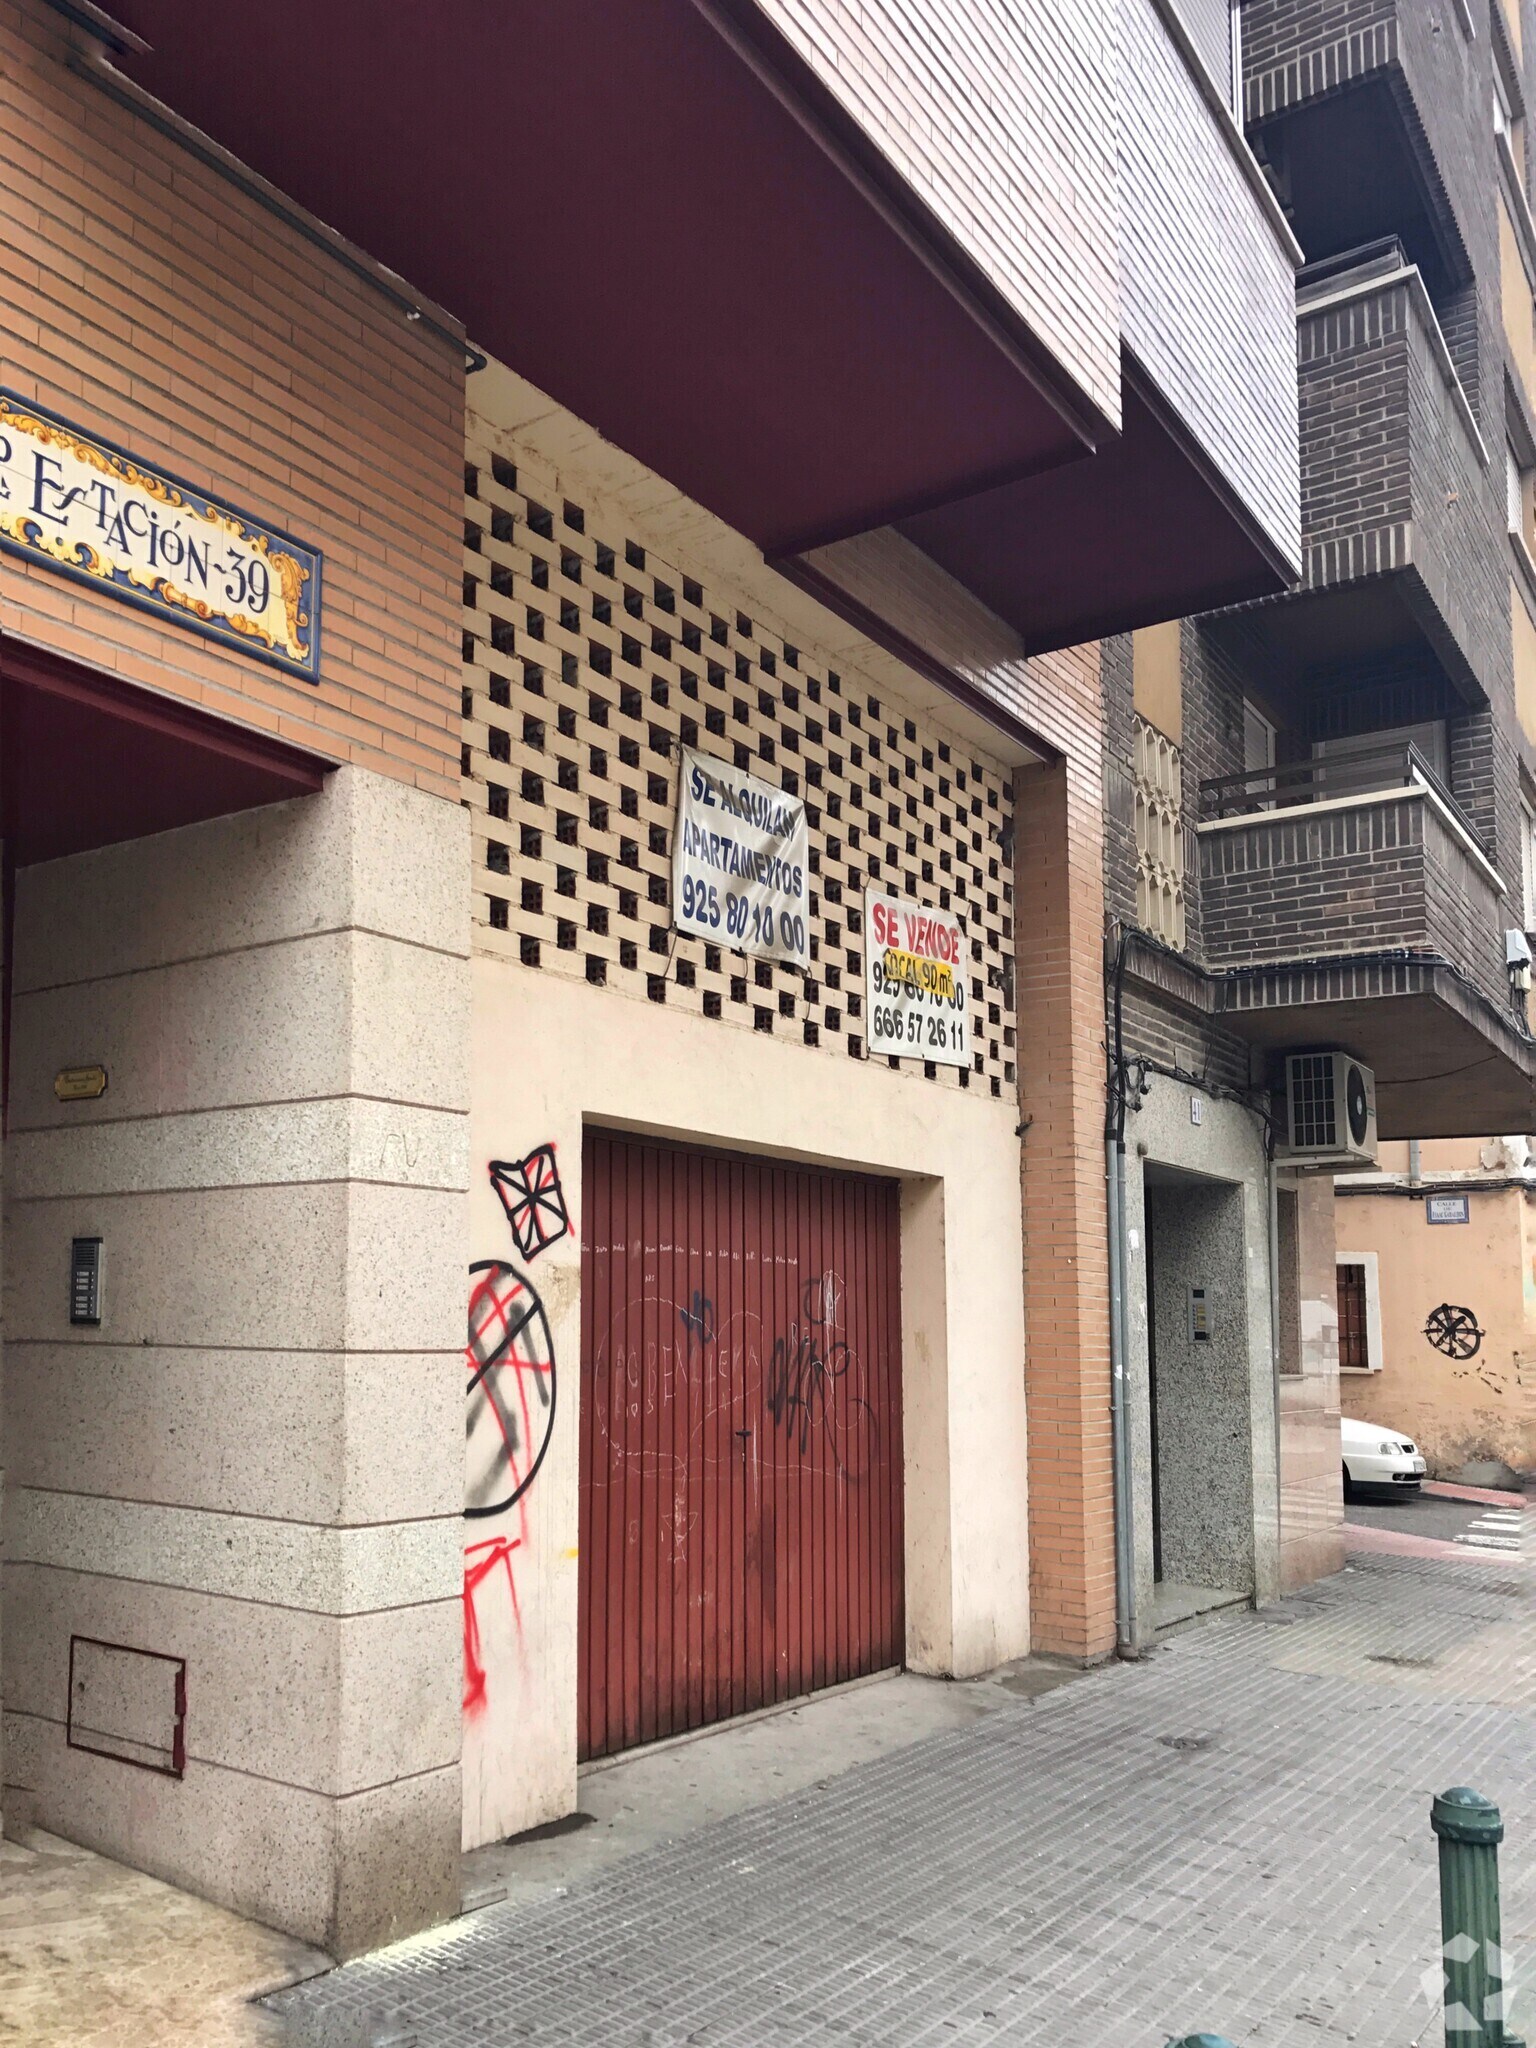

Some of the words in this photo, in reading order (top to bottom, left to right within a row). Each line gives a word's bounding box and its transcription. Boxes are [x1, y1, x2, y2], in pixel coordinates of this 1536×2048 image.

[691, 766, 716, 807] SE
[720, 780, 797, 842] ALQUILAN
[683, 818, 803, 898] APARTAMENTOS
[682, 874, 721, 929] 925
[726, 891, 749, 939] 80
[752, 902, 774, 947] 10
[779, 911, 805, 955] 00
[872, 902, 900, 948] SE
[904, 912, 960, 965] VENDE
[922, 962, 938, 987] 90
[873, 1005, 904, 1040] 666
[907, 1012, 923, 1044] 57
[927, 1016, 947, 1048] 26
[950, 1020, 964, 1052] 11
